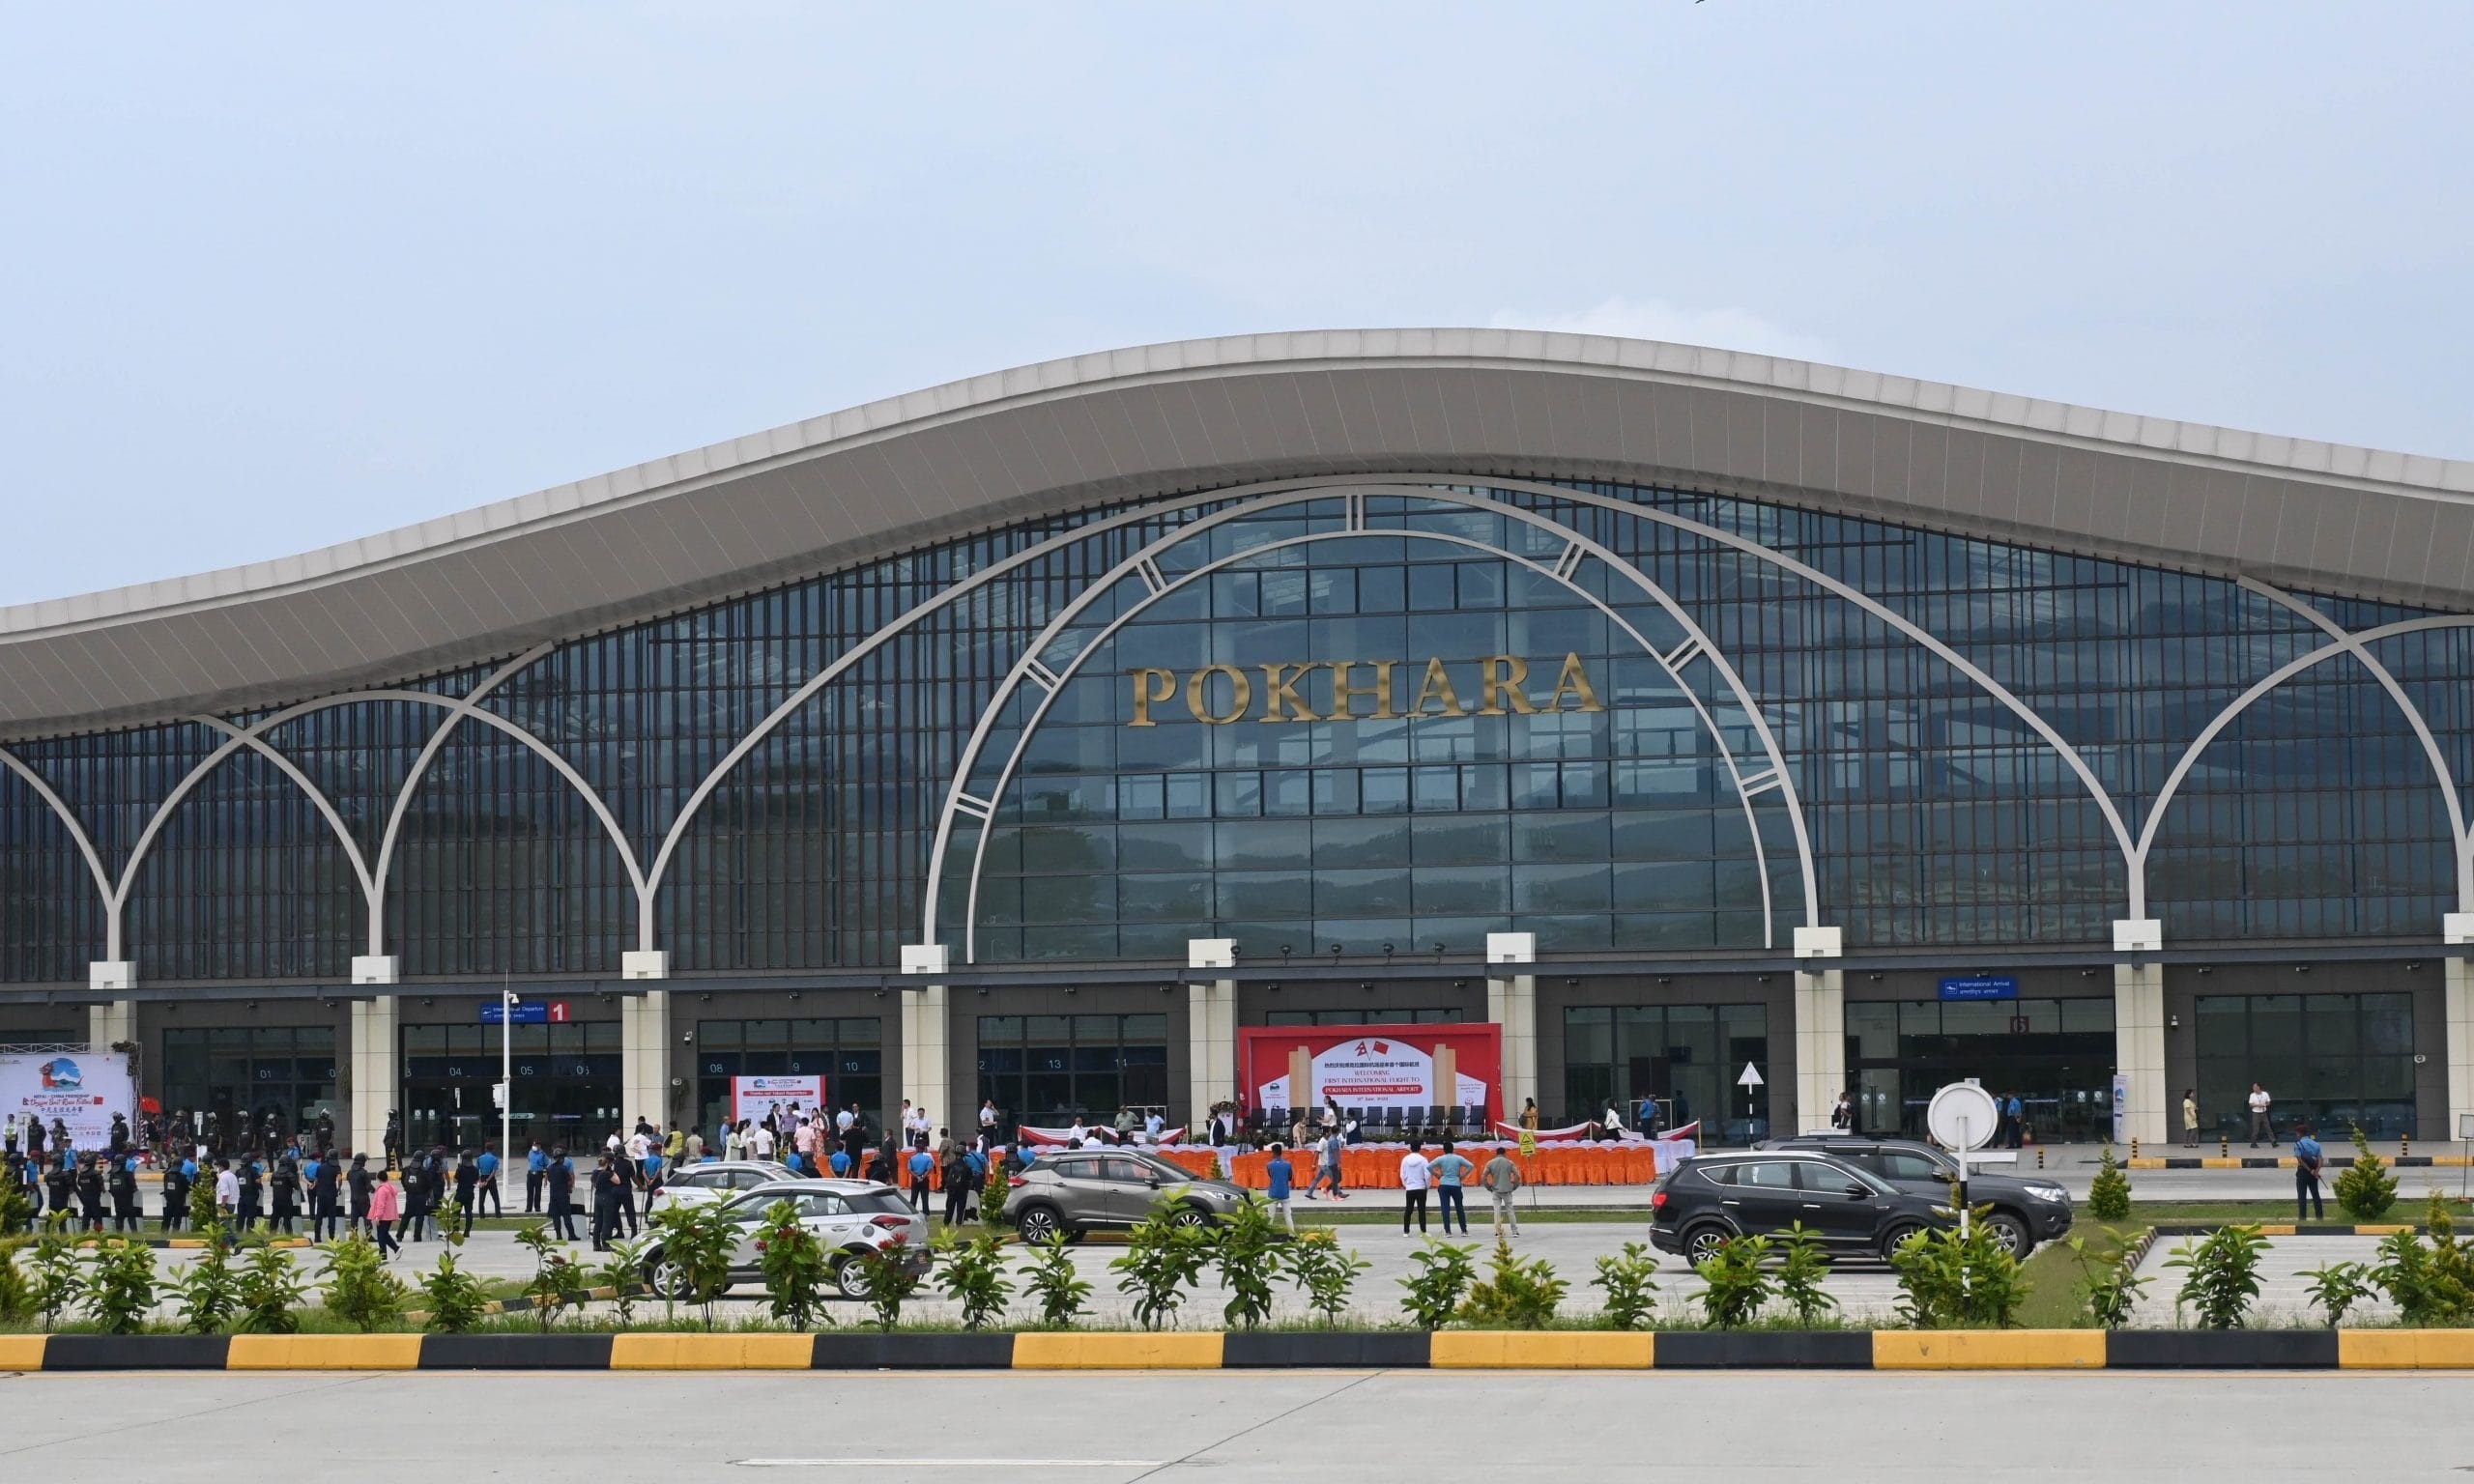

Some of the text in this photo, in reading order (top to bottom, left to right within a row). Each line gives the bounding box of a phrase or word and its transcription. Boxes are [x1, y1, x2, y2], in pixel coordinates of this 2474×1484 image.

[1126, 651, 1606, 728] POKHARA
[553, 1004, 563, 1021] 1
[2013, 1017, 2027, 1034] 6
[709, 1064, 724, 1073] 08
[792, 1063, 800, 1072] 9
[847, 1062, 858, 1071] 10
[979, 1061, 986, 1070] 2
[1049, 1059, 1062, 1070] 13
[448, 1067, 462, 1077] 04
[520, 1066, 533, 1075] 05
